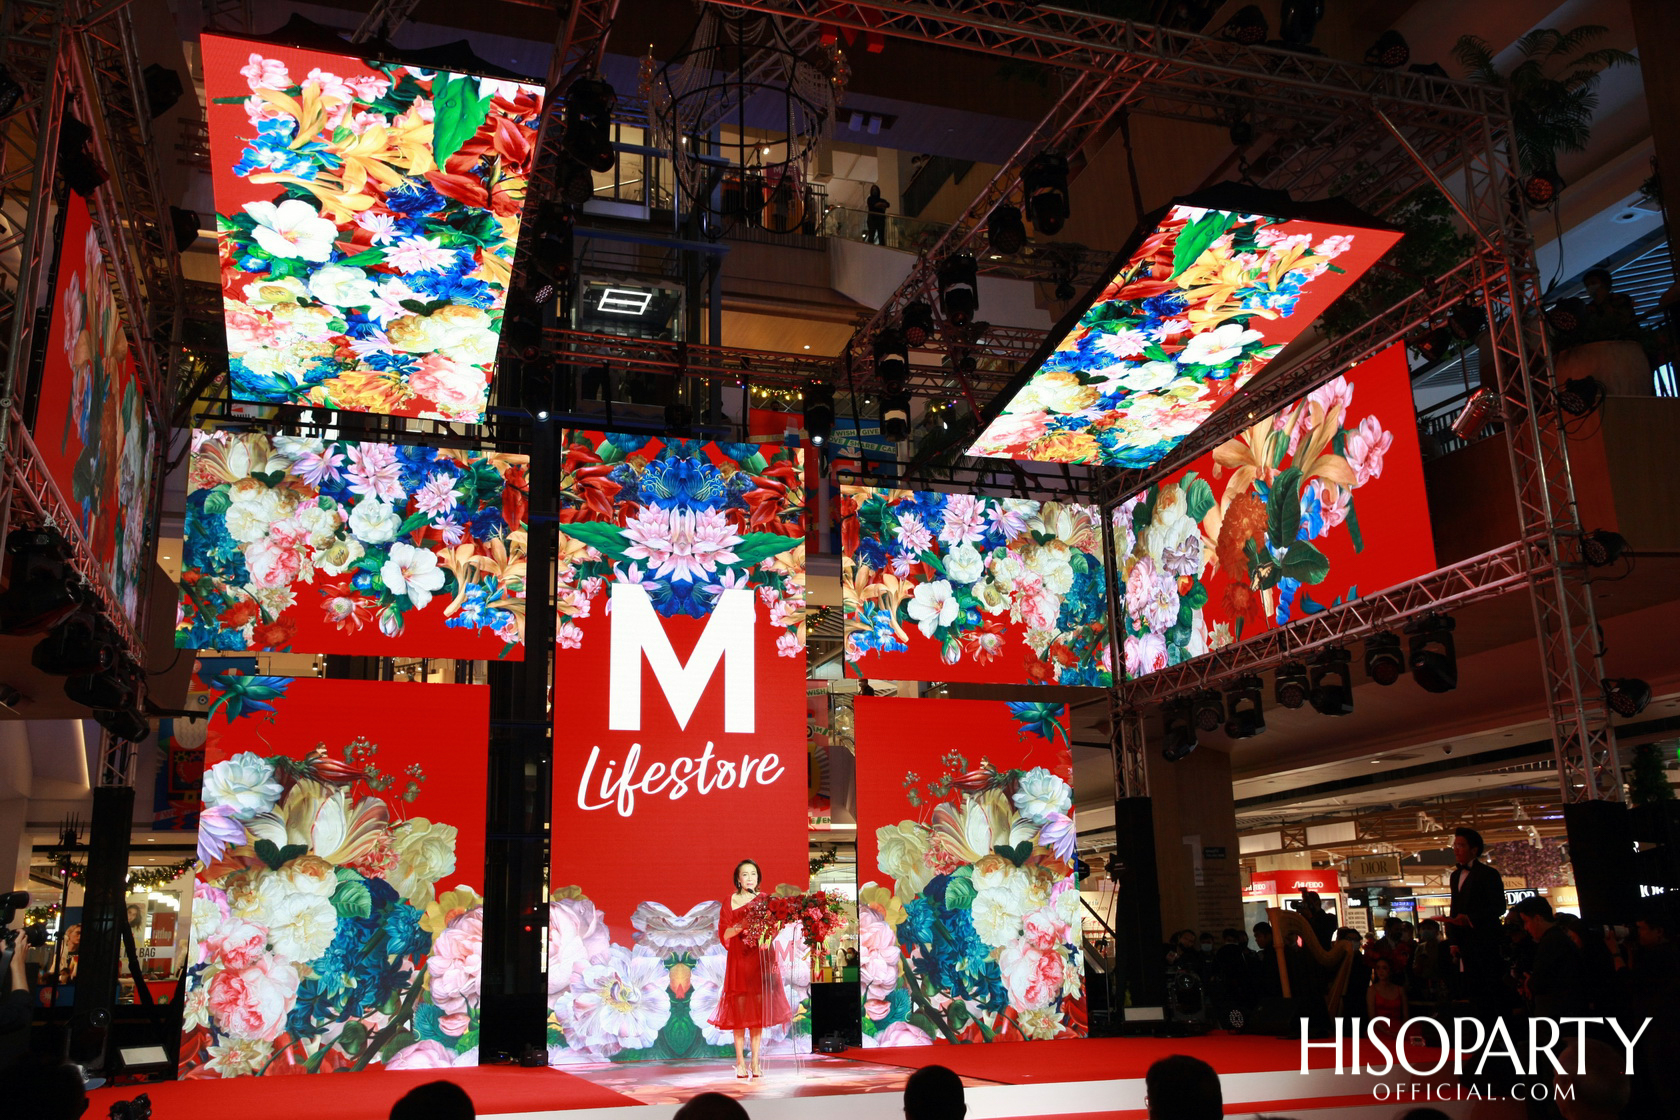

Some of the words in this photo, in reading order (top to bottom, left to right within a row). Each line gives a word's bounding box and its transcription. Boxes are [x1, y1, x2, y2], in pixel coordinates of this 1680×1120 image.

[828, 436, 843, 444] OVE
[849, 440, 875, 450] SHARE
[609, 583, 755, 733] M
[808, 688, 826, 696] WISH
[577, 741, 785, 817] Lifestore
[1360, 861, 1388, 875] DIOR
[1291, 881, 1324, 889] SHISEIDO
[139, 947, 156, 958] BAG
[775, 940, 794, 962] M
